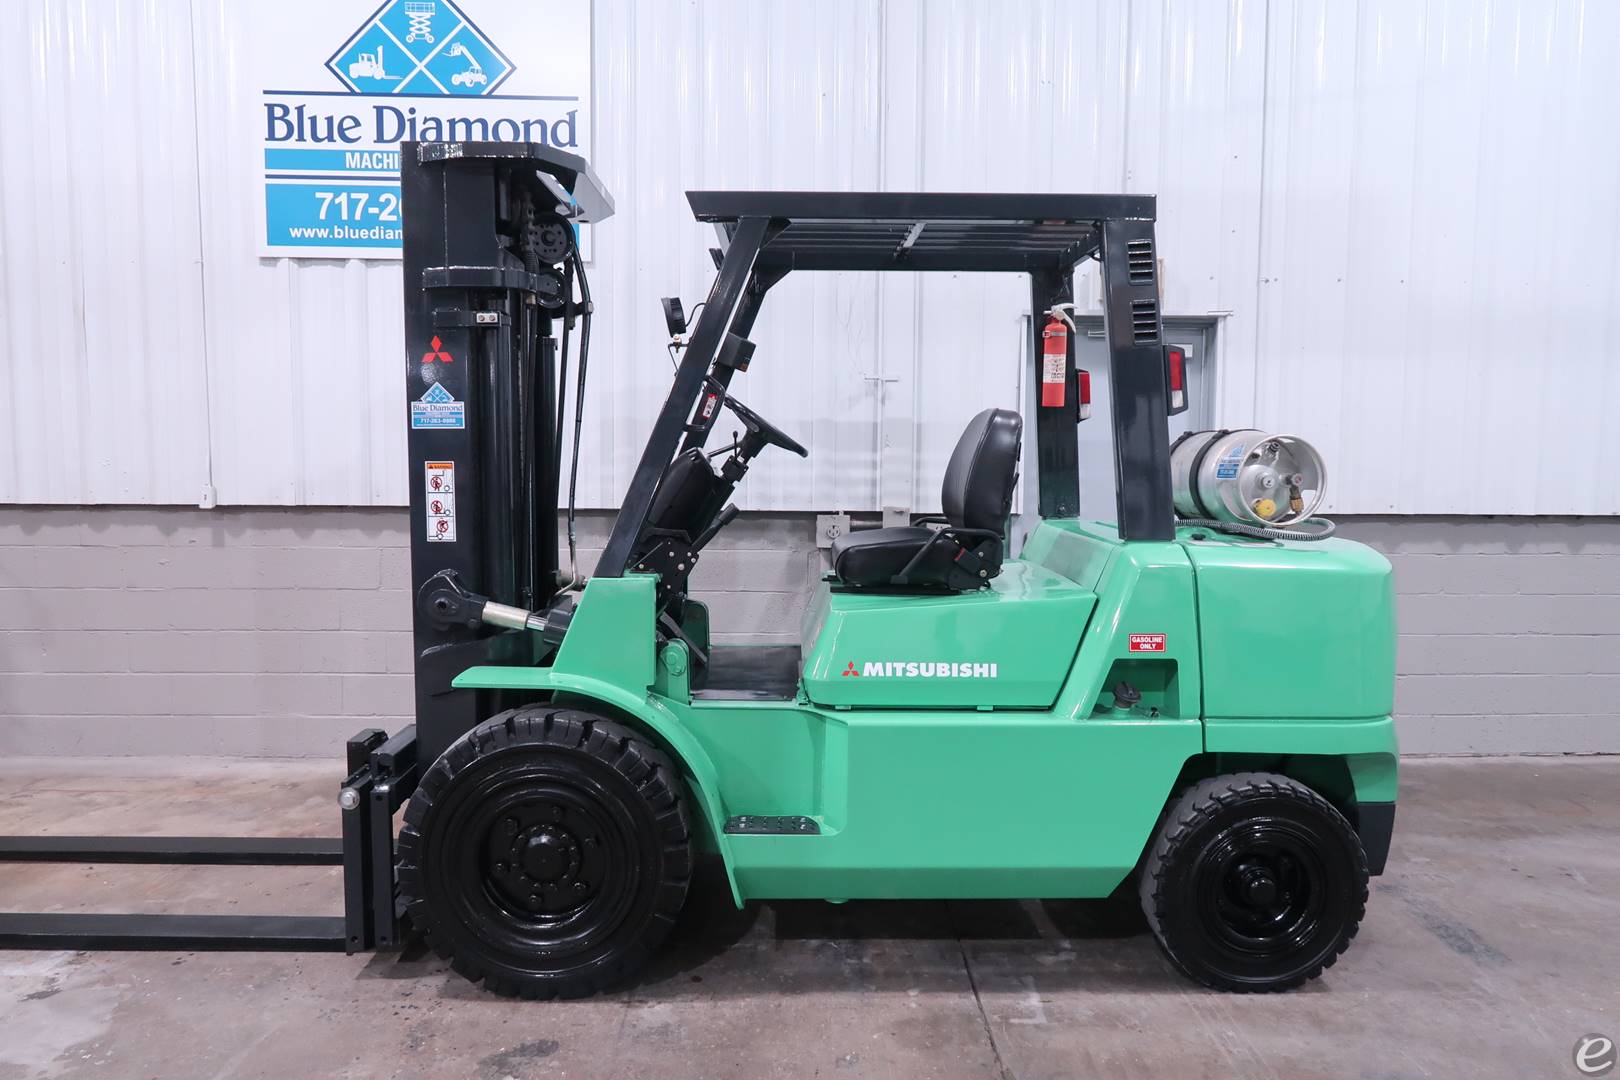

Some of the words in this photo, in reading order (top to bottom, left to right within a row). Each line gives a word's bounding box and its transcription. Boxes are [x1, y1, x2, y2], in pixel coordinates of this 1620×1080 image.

[264, 103, 362, 143] Blue
[372, 105, 578, 148] Diamond
[315, 192, 402, 221] 717-2
[862, 662, 998, 678] MITSUBISHI
